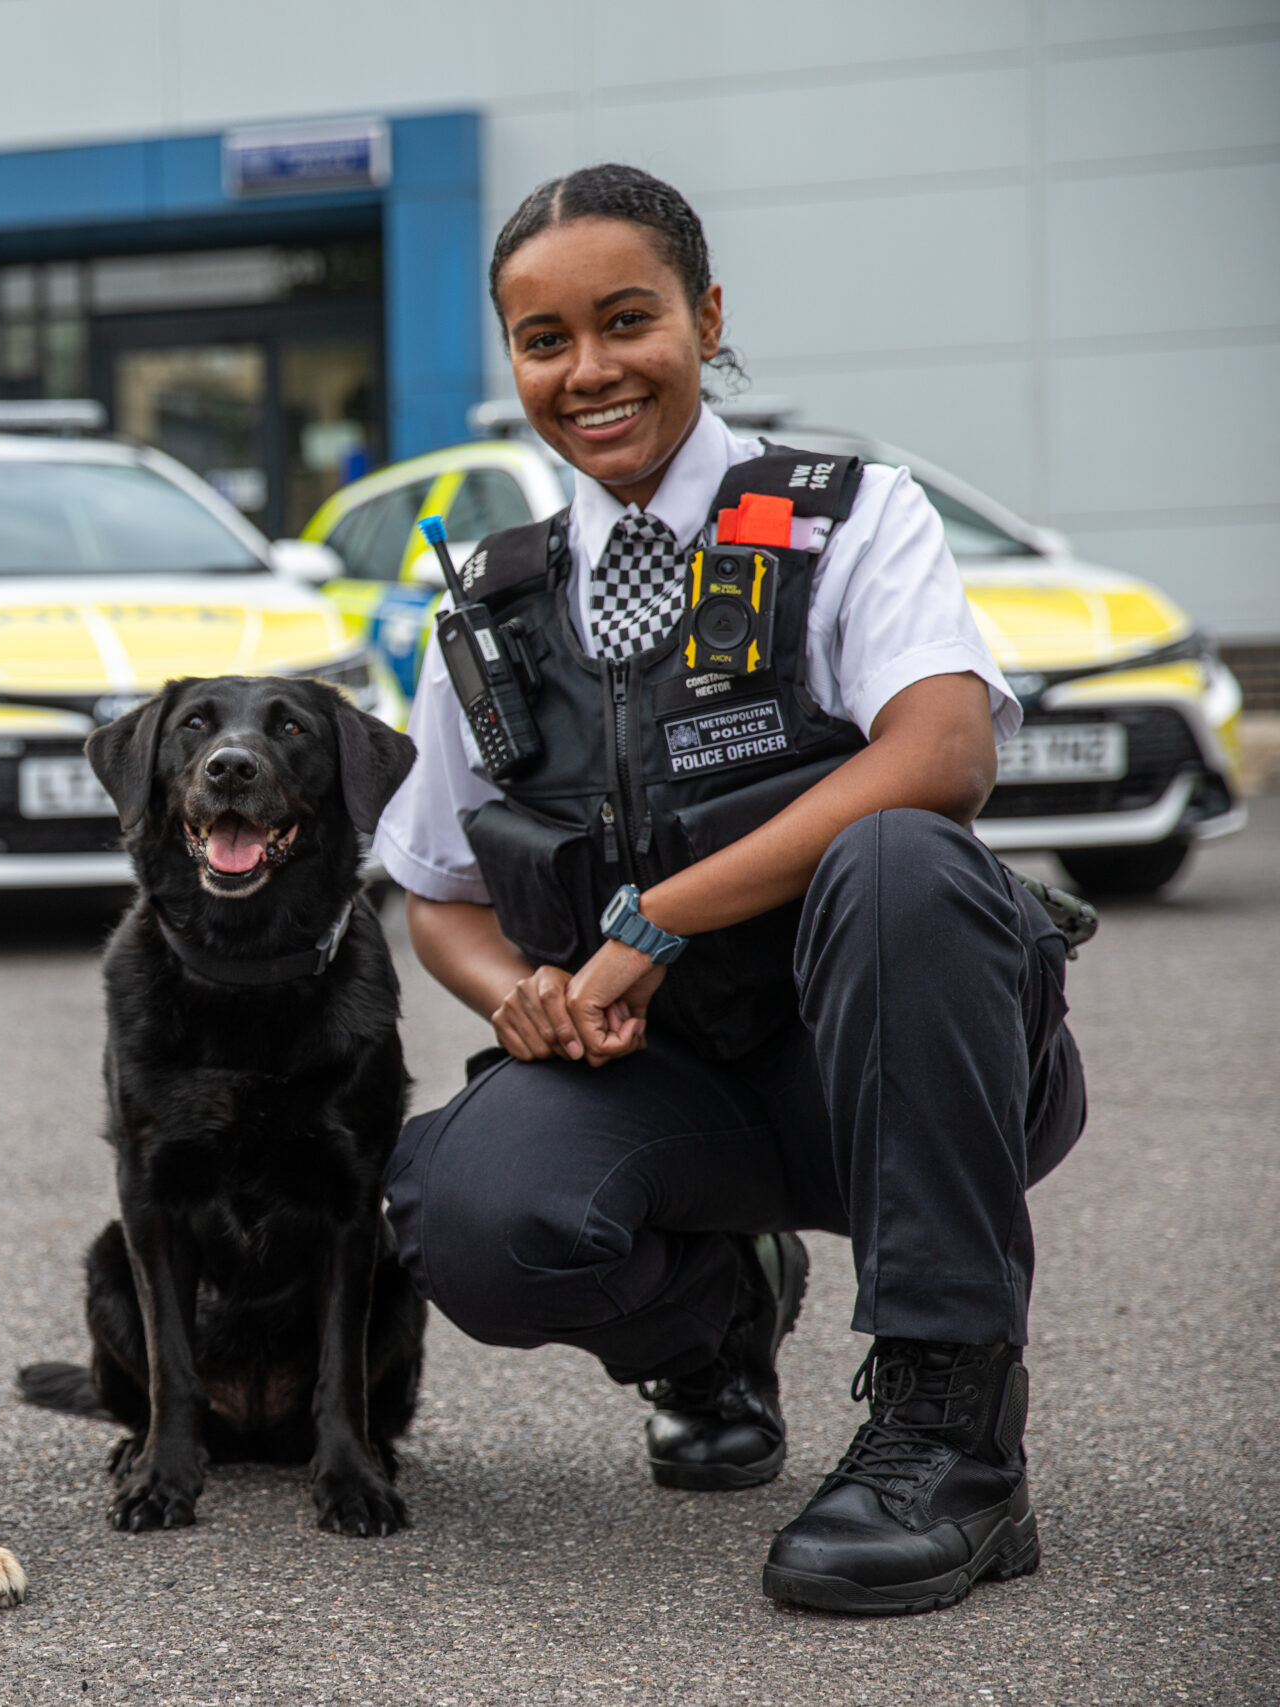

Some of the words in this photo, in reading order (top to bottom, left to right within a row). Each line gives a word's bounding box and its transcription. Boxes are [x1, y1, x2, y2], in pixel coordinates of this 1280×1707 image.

[788, 464, 813, 488] NW
[809, 462, 836, 491] 1412
[709, 654, 732, 663] AXON
[685, 672, 736, 689] CONSTAB
[695, 681, 731, 698] HECTOR
[699, 706, 774, 730] METROPOLITAN
[710, 720, 768, 741] POLICE
[671, 748, 724, 773] POLICE
[726, 734, 788, 761] OFFICER
